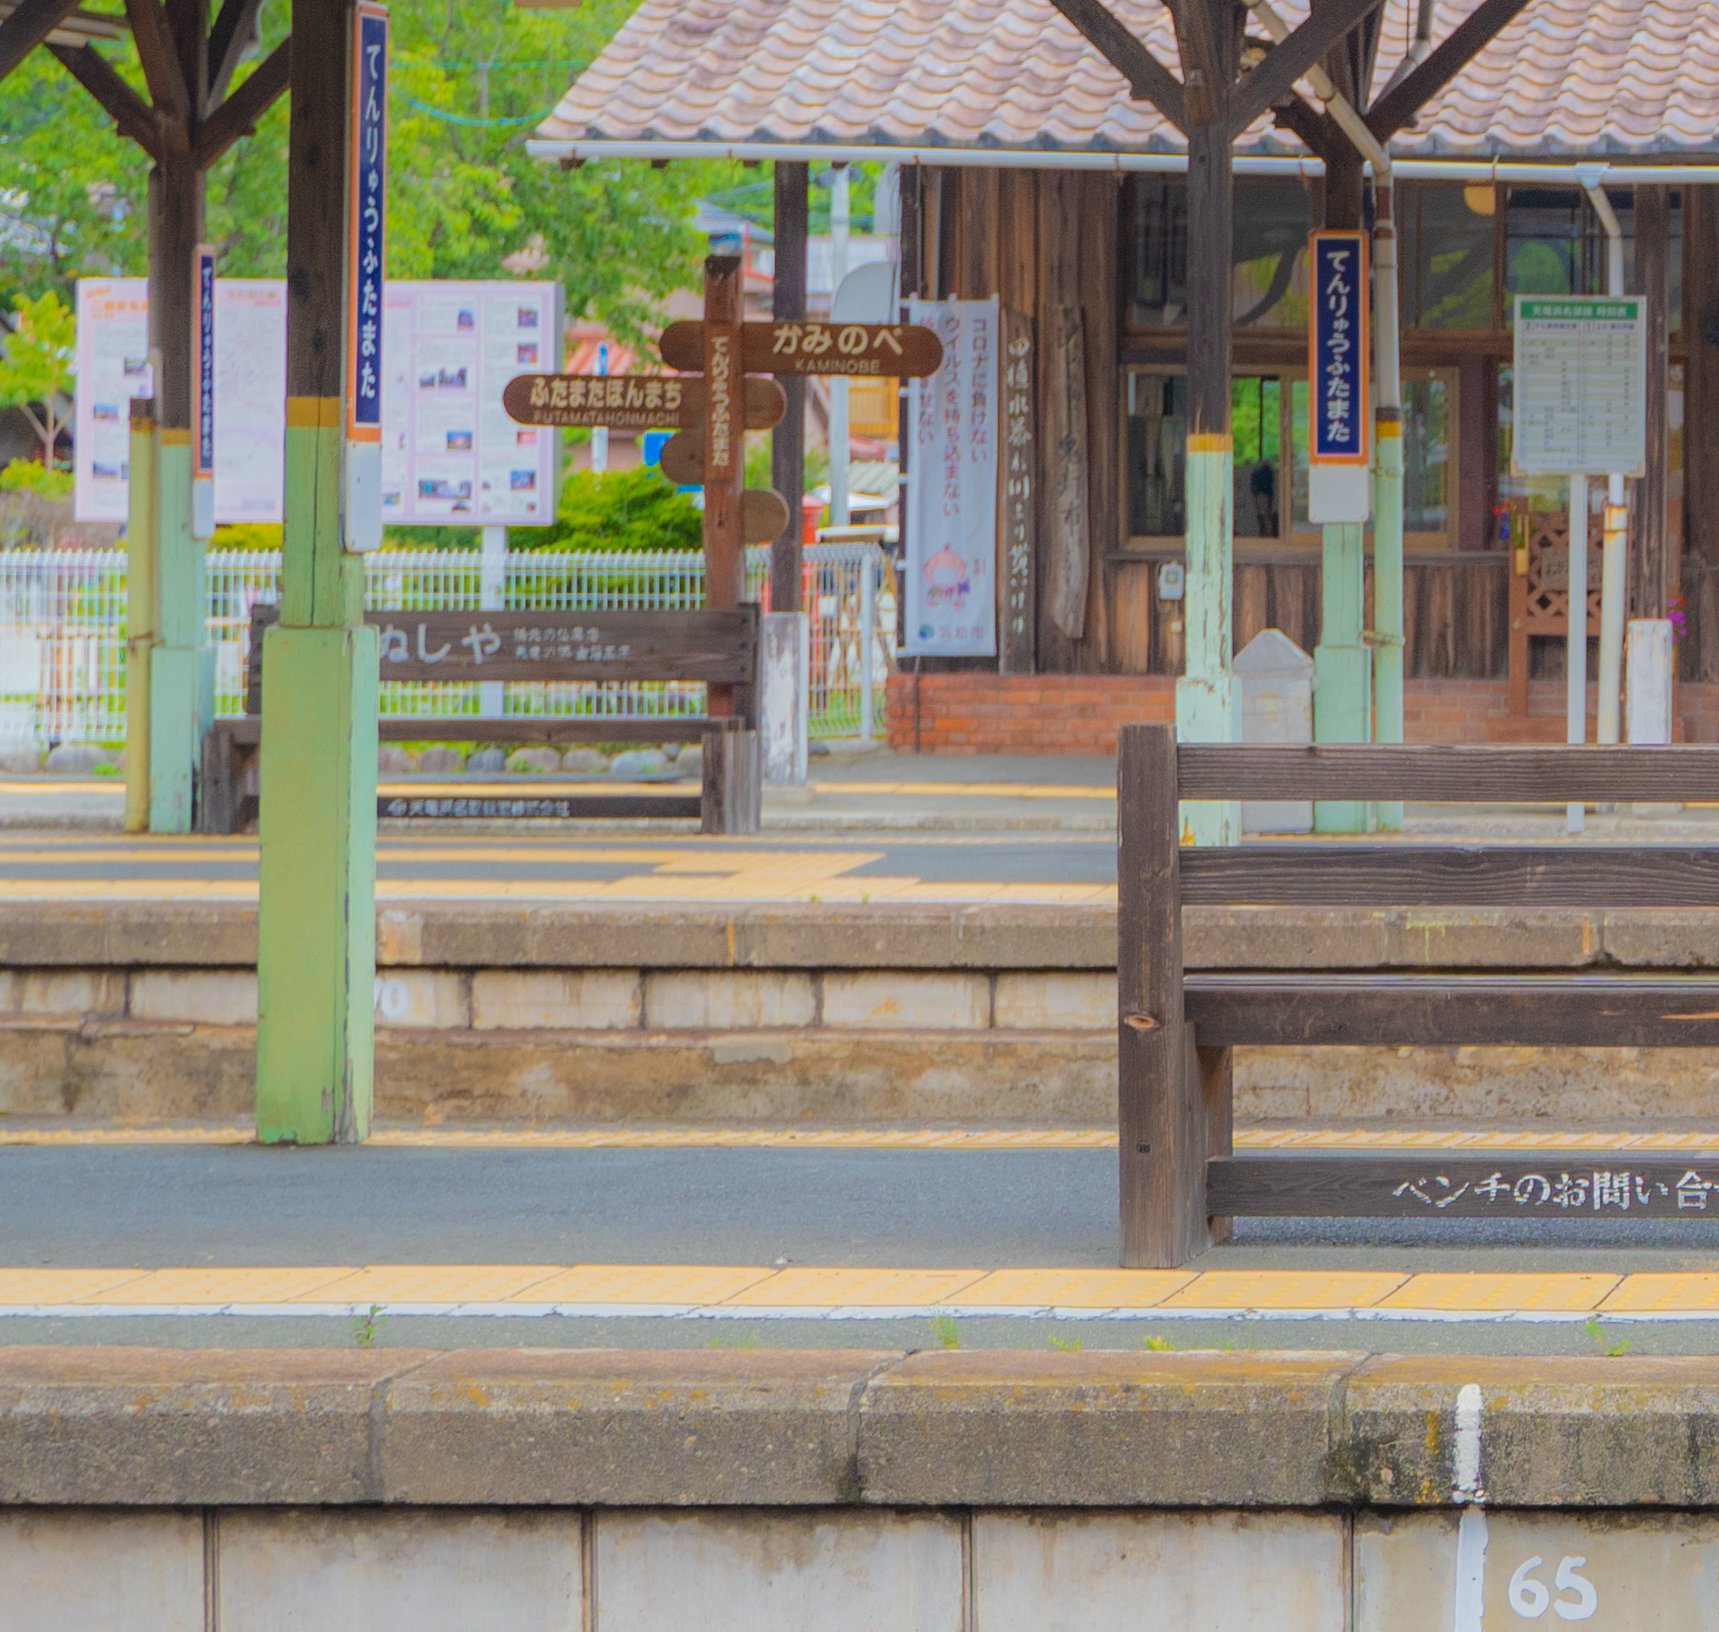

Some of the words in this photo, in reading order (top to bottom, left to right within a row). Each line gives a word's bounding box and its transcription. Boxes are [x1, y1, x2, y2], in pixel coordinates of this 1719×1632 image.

[360, 42, 382, 399] てんりゅうふたまた
[772, 323, 904, 356] かみのべ
[795, 359, 881, 375] KAMINOBE
[971, 317, 988, 464] コロナに負けない
[1326, 250, 1351, 443] てんりゅうふたまた
[530, 377, 683, 409] ふたまたほんまち
[943, 317, 961, 517] ウイルスを持ち込まない
[1507, 1555, 1598, 1621] 65
